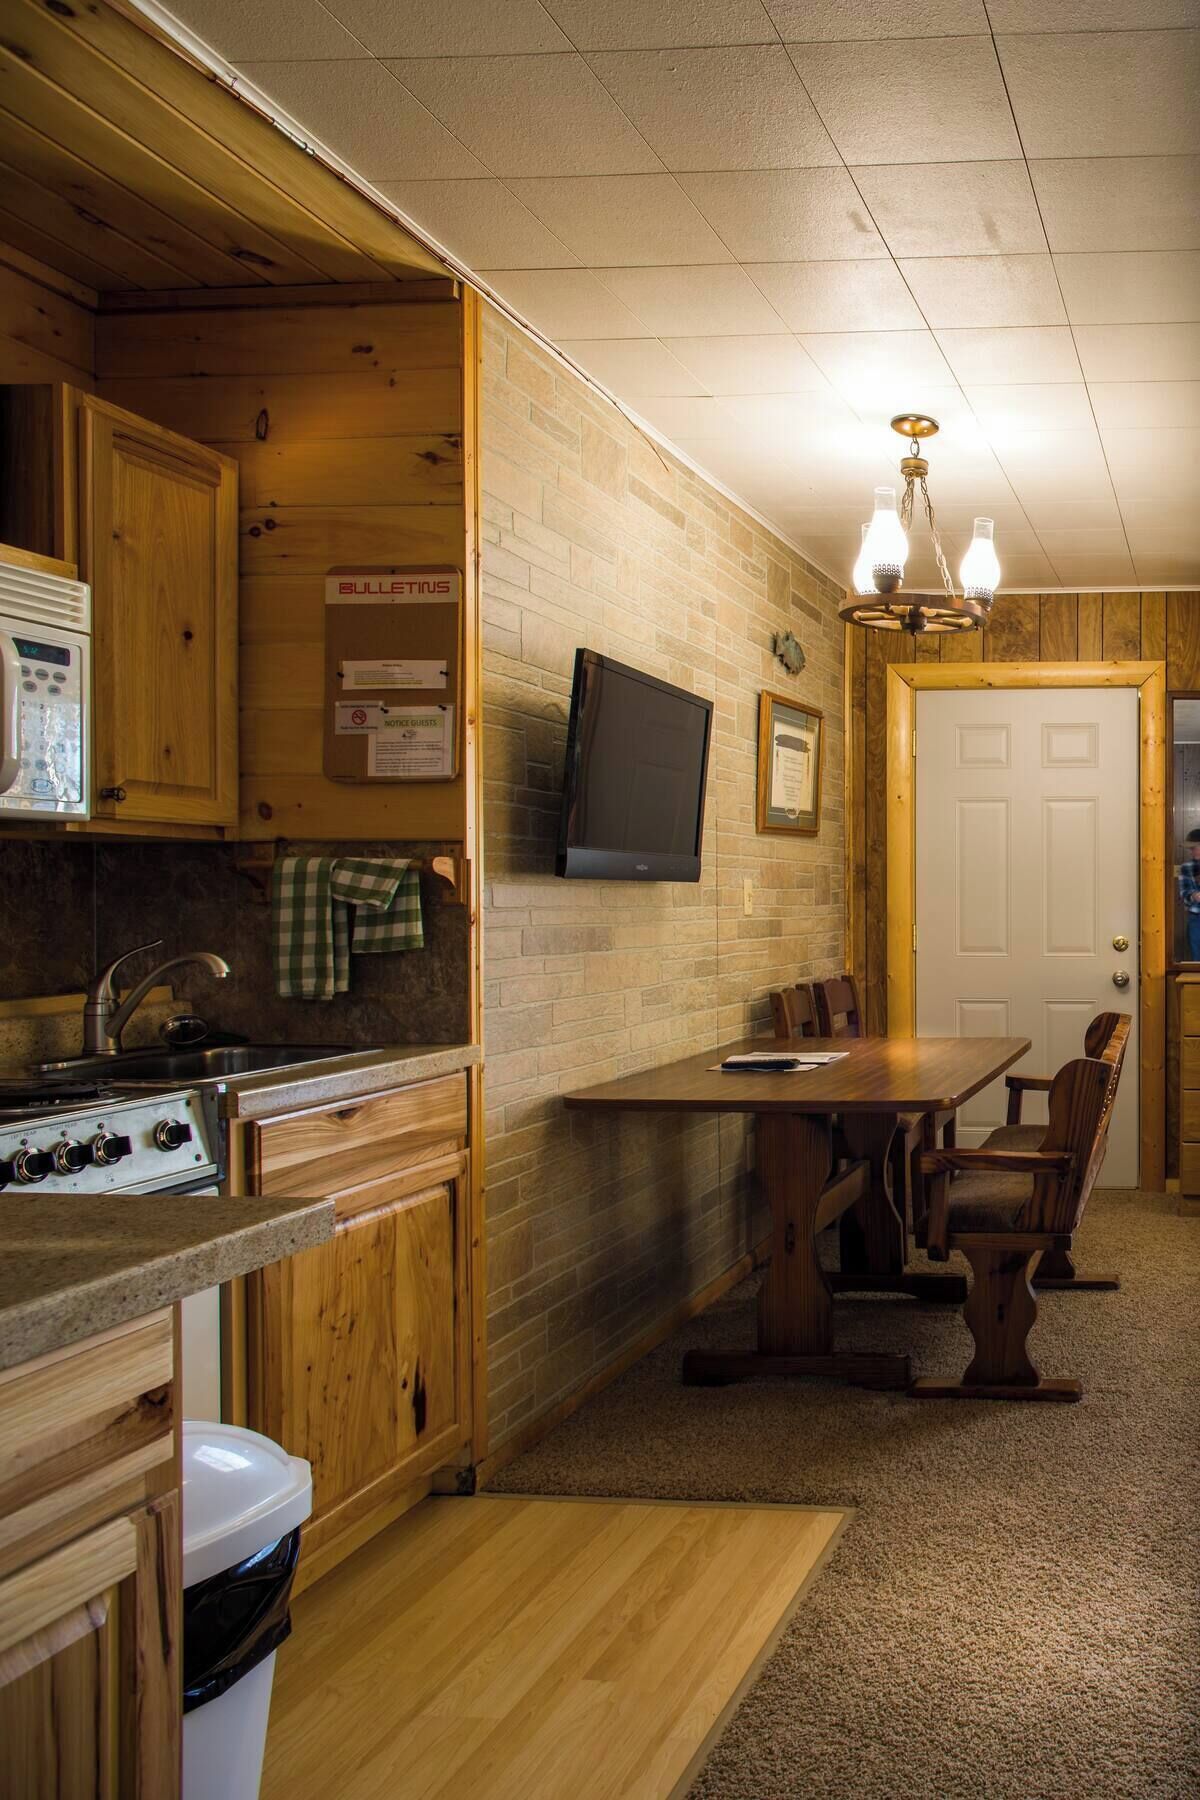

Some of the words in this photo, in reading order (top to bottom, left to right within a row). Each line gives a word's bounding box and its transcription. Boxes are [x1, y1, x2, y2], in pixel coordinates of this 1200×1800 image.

[339, 581, 450, 594] BULLETINS
[384, 719, 409, 727] NOTICE
[411, 719, 437, 727] GUESTS
